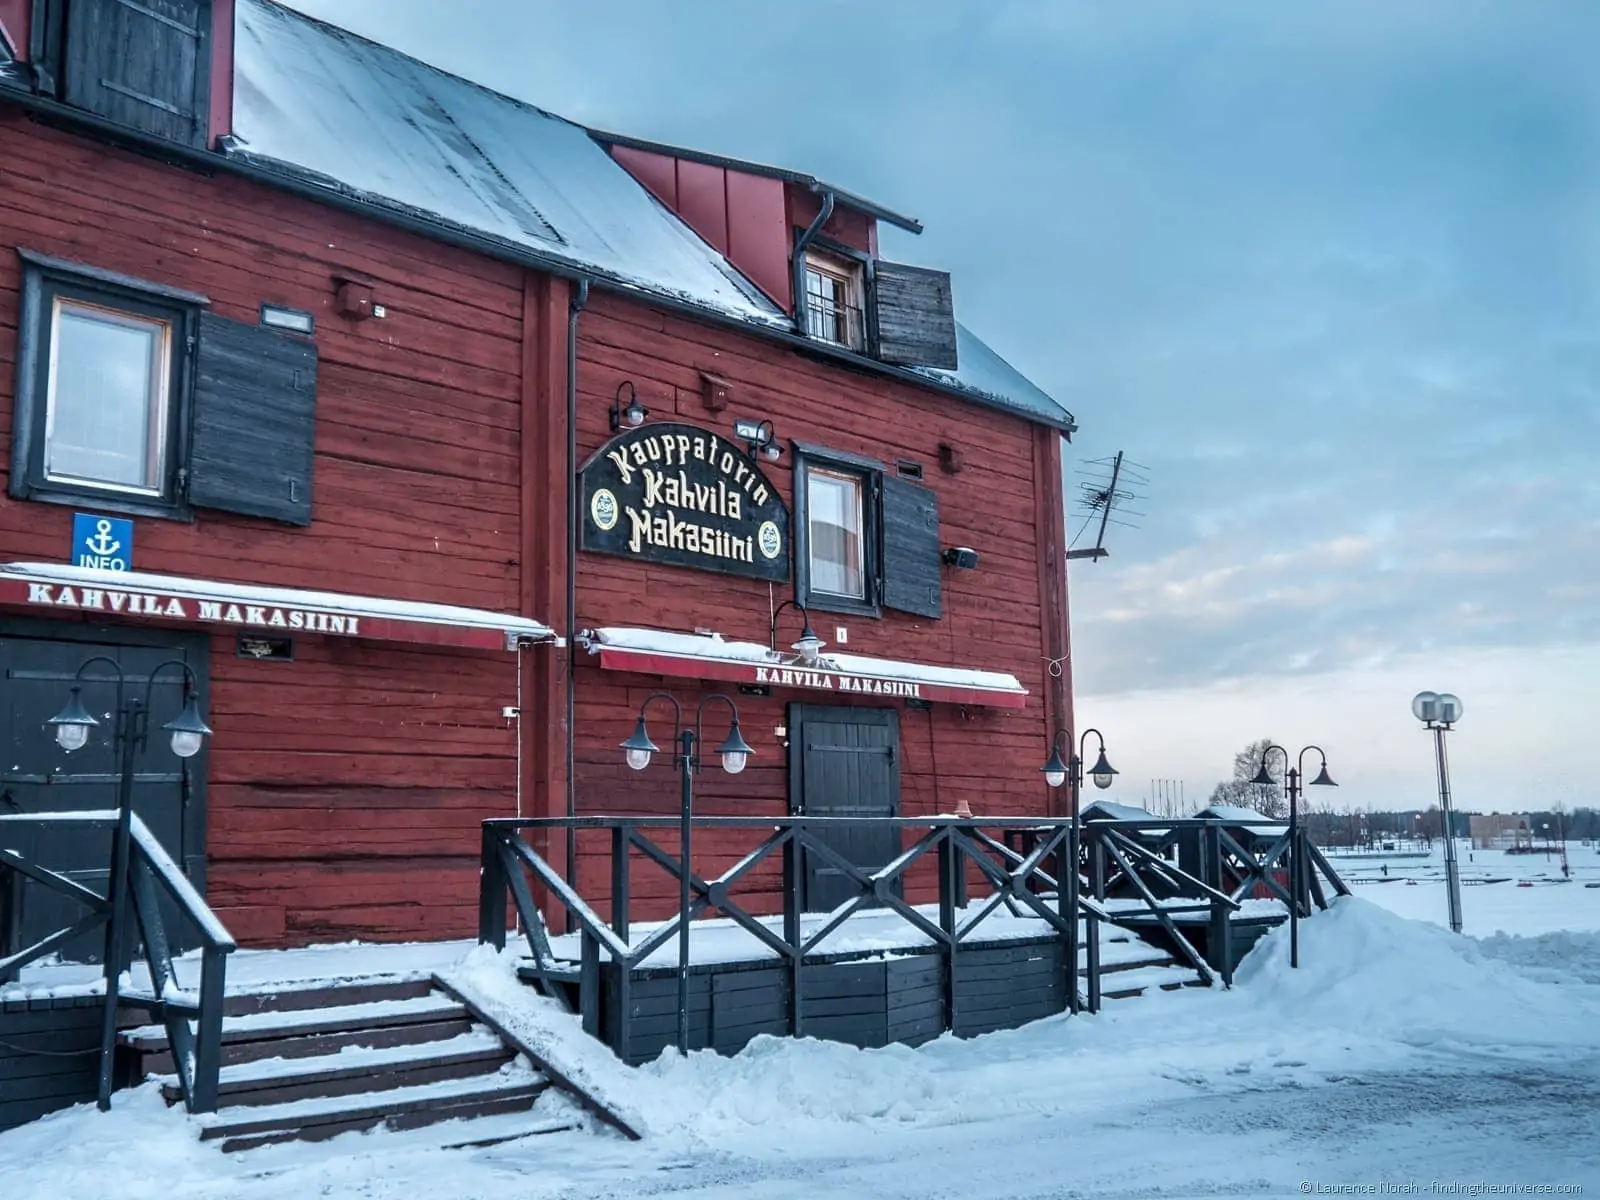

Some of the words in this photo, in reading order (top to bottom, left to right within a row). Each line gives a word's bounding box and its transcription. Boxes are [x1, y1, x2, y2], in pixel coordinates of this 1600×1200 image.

[607, 435, 769, 506] Kauppatorin
[642, 468, 741, 520] Kahvila
[625, 506, 754, 563] Makasiini
[80, 554, 125, 571] INFO
[27, 582, 186, 618] KAHVILA
[198, 600, 359, 634] MAKASIINI
[756, 667, 832, 688] KAHVILA
[838, 677, 920, 697] MAKASIINI
